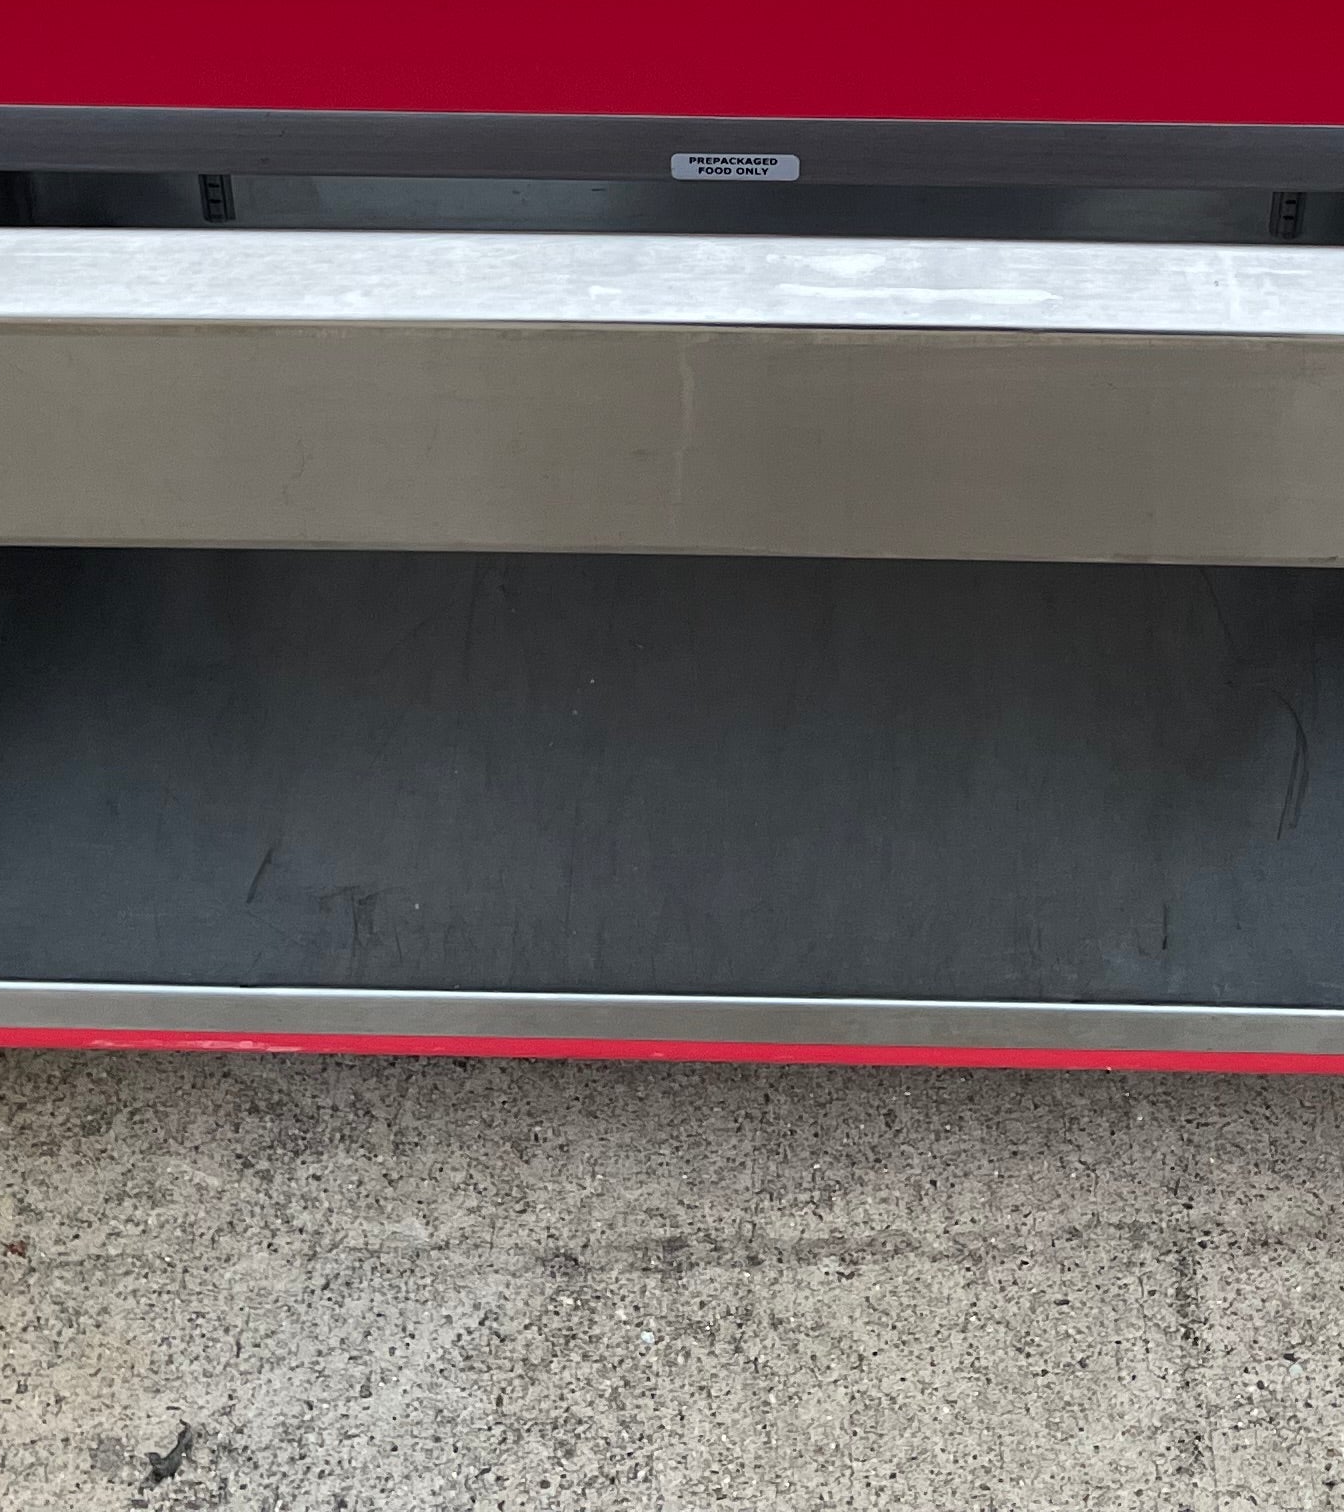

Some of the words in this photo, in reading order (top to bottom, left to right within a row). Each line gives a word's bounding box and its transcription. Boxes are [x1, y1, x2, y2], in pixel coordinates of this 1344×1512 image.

[689, 157, 778, 166] PREPACKAGED
[698, 167, 732, 175] FOOD
[736, 168, 769, 176] ONLY
